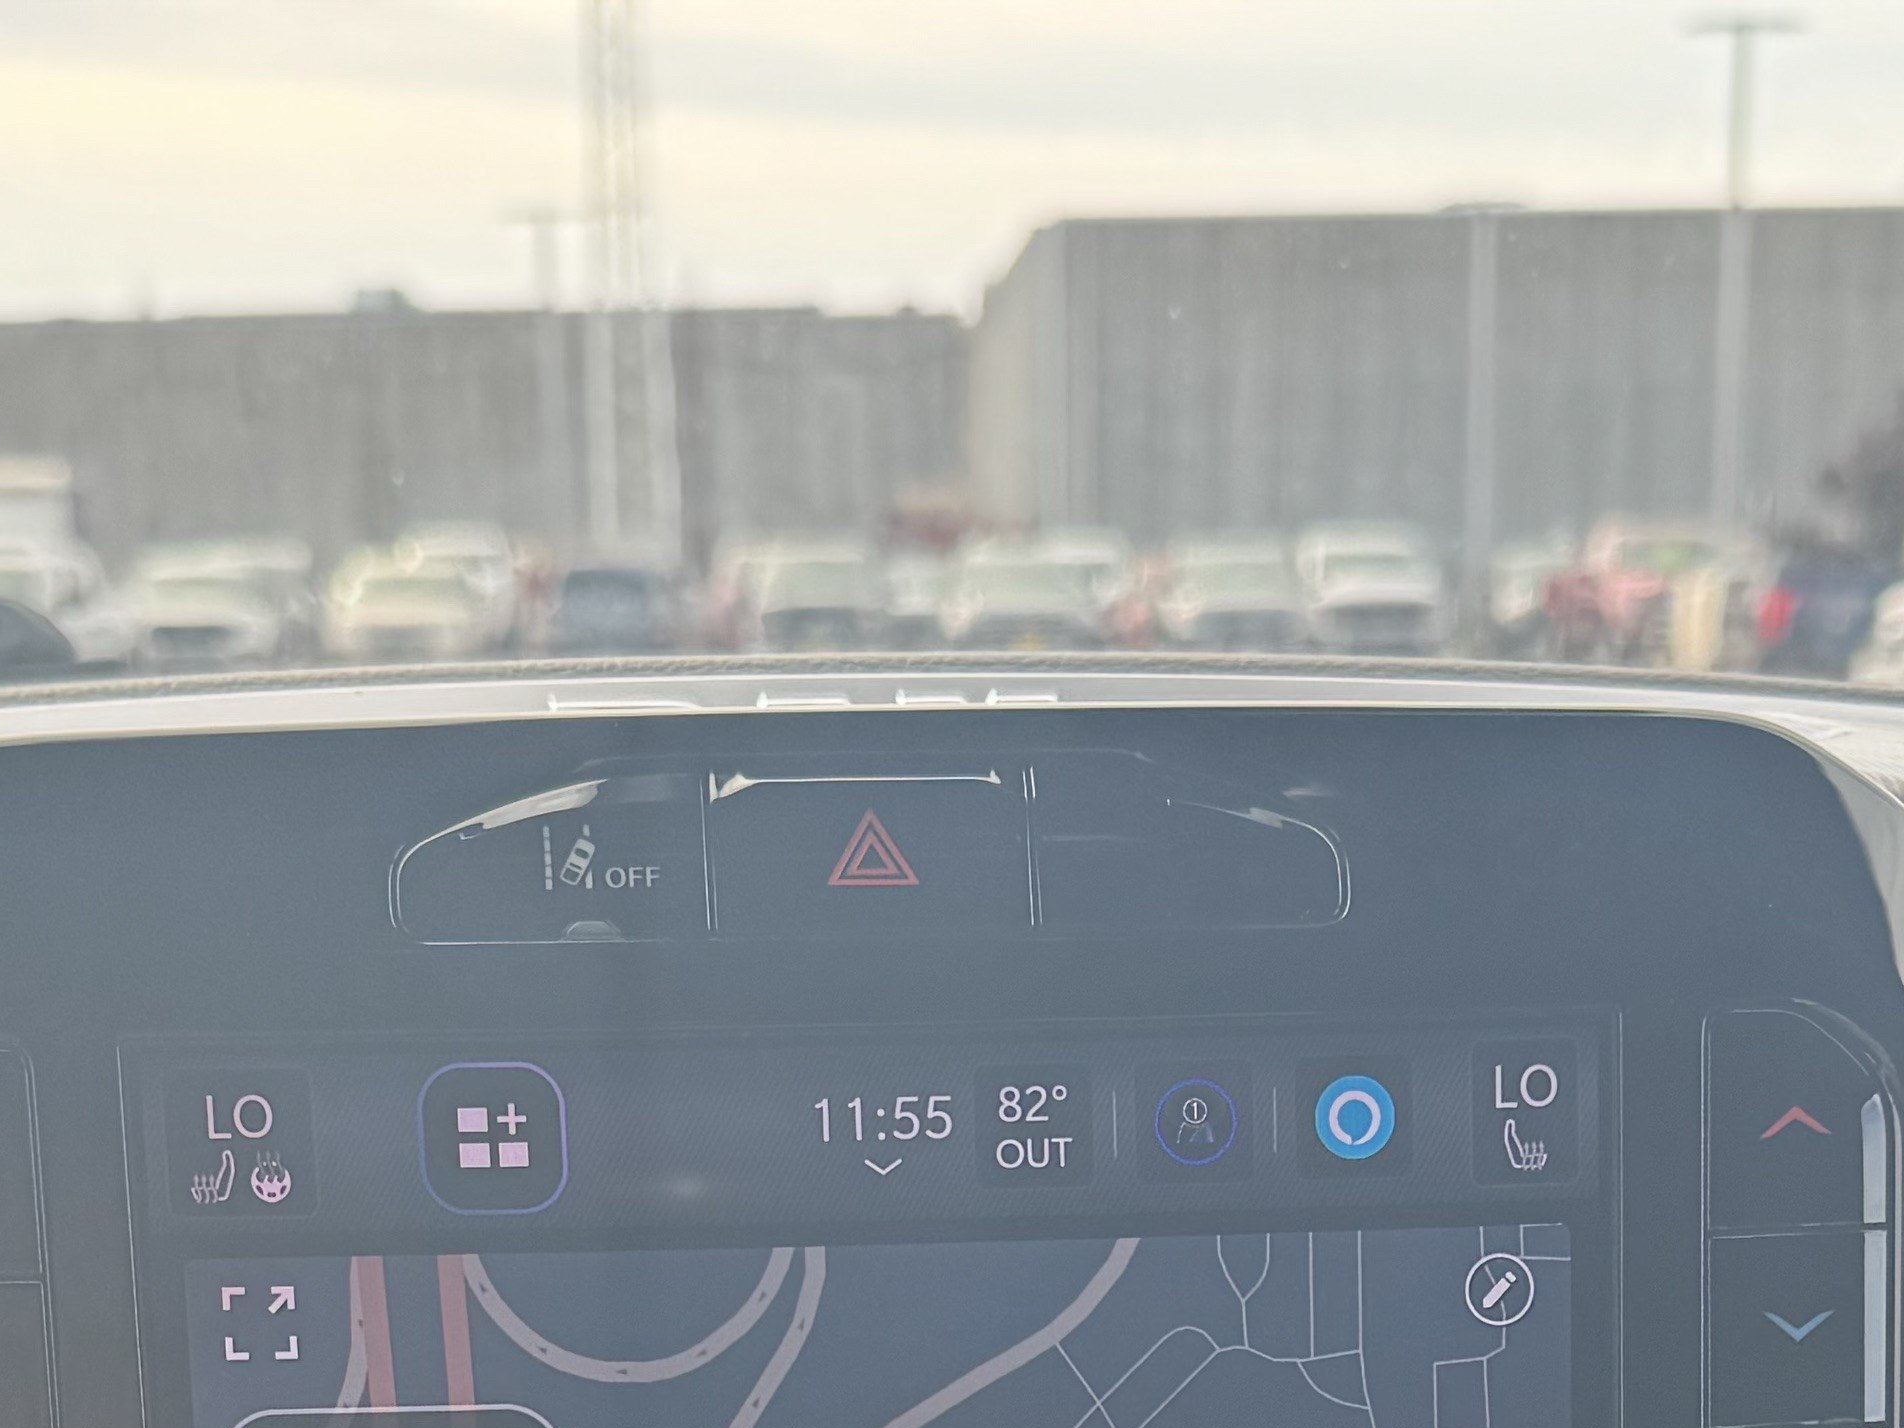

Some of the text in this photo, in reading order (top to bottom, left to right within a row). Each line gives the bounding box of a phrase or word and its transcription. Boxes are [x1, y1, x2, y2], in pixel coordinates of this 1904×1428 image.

[605, 866, 660, 888] OFF
[998, 1085, 1068, 1123] 82°
[1495, 1063, 1558, 1110] LO
[206, 1094, 273, 1140] LO
[812, 1094, 954, 1144] 11:55
[996, 1137, 1072, 1169] OUT
